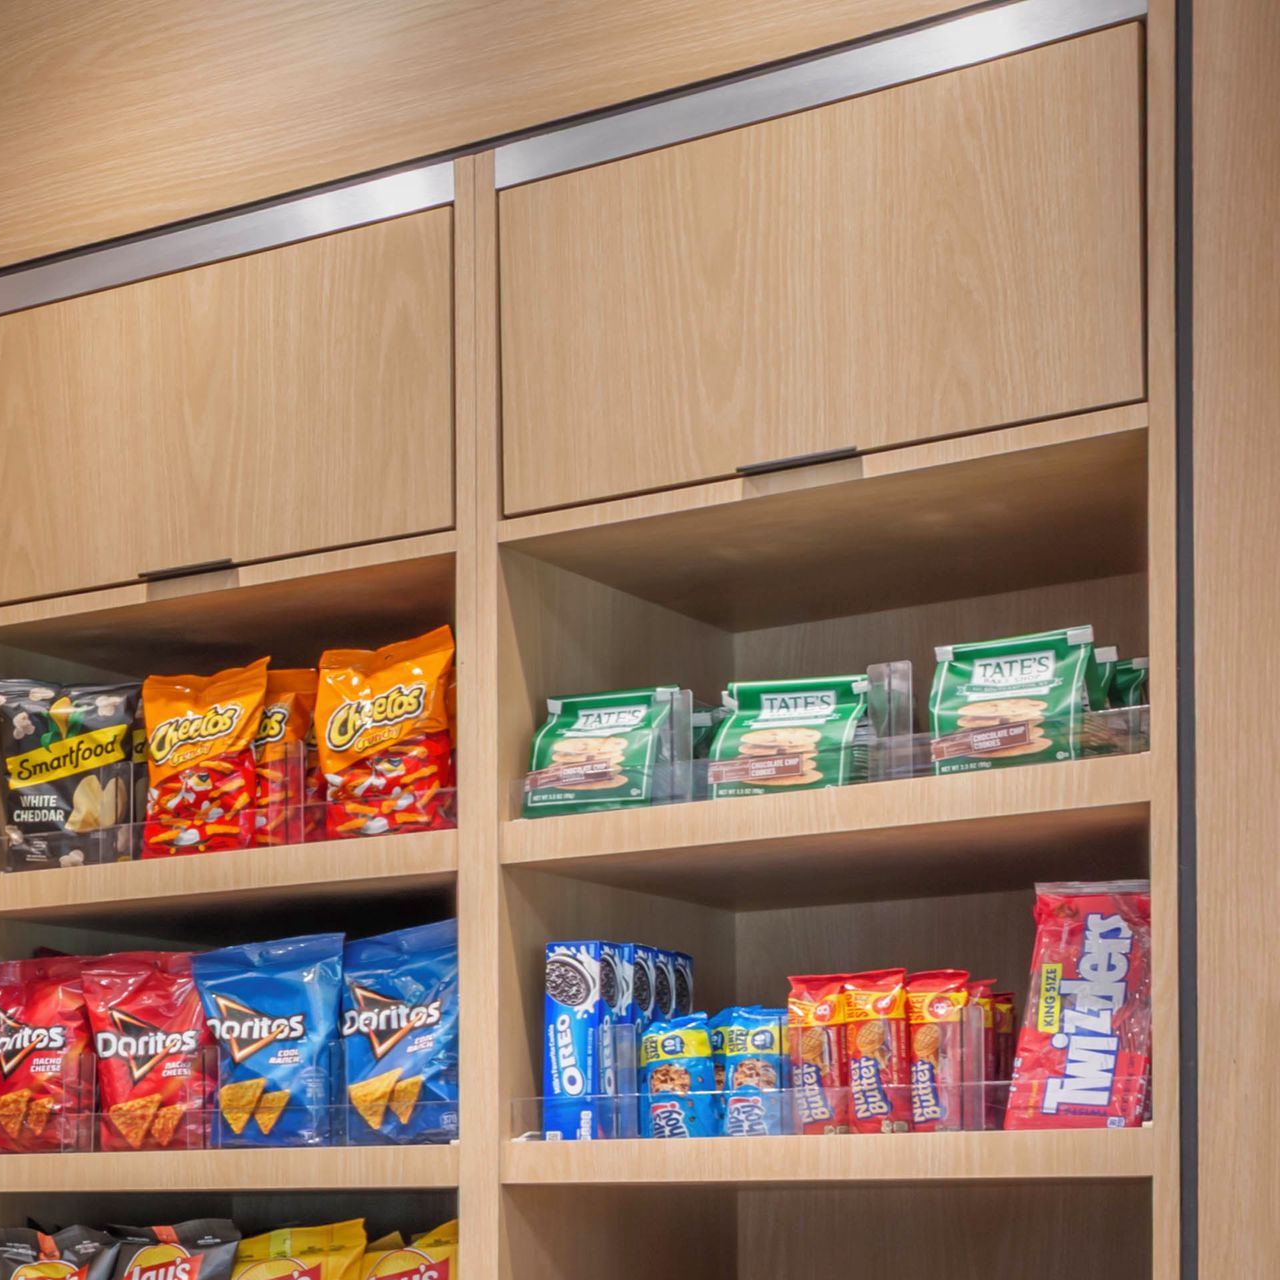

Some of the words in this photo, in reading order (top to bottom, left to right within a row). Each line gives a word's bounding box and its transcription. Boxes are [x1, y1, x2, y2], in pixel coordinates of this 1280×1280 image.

[978, 656, 1050, 679] TATE'S
[764, 694, 831, 713] TATE'S
[328, 686, 424, 749] Cheetos
[581, 709, 641, 726] TATE'S
[149, 706, 237, 762] Cheetos
[973, 730, 1008, 742] CHOCOLATE
[1009, 726, 1025, 736] CHIP
[973, 740, 1001, 750] COOKIES
[17, 735, 118, 780] Smartfood
[751, 759, 785, 770] CHOCOLATE
[785, 757, 799, 767] CHIP
[751, 768, 776, 777] COOKIES
[20, 795, 57, 807] WHITE
[13, 809, 65, 822] CHEDDAR
[1047, 967, 1057, 994] SIZE
[342, 1001, 441, 1037] Doritos
[1045, 995, 1056, 1027] KING
[96, 1030, 194, 1059] Doritos
[556, 1013, 584, 1097] OREO
[30, 1064, 62, 1073] CHEESE
[32, 1057, 62, 1065] NACHO
[268, 1056, 301, 1065] RANCH
[851, 1060, 871, 1119] Nutter
[861, 1058, 889, 1115] Butter
[918, 1061, 940, 1120] Butter
